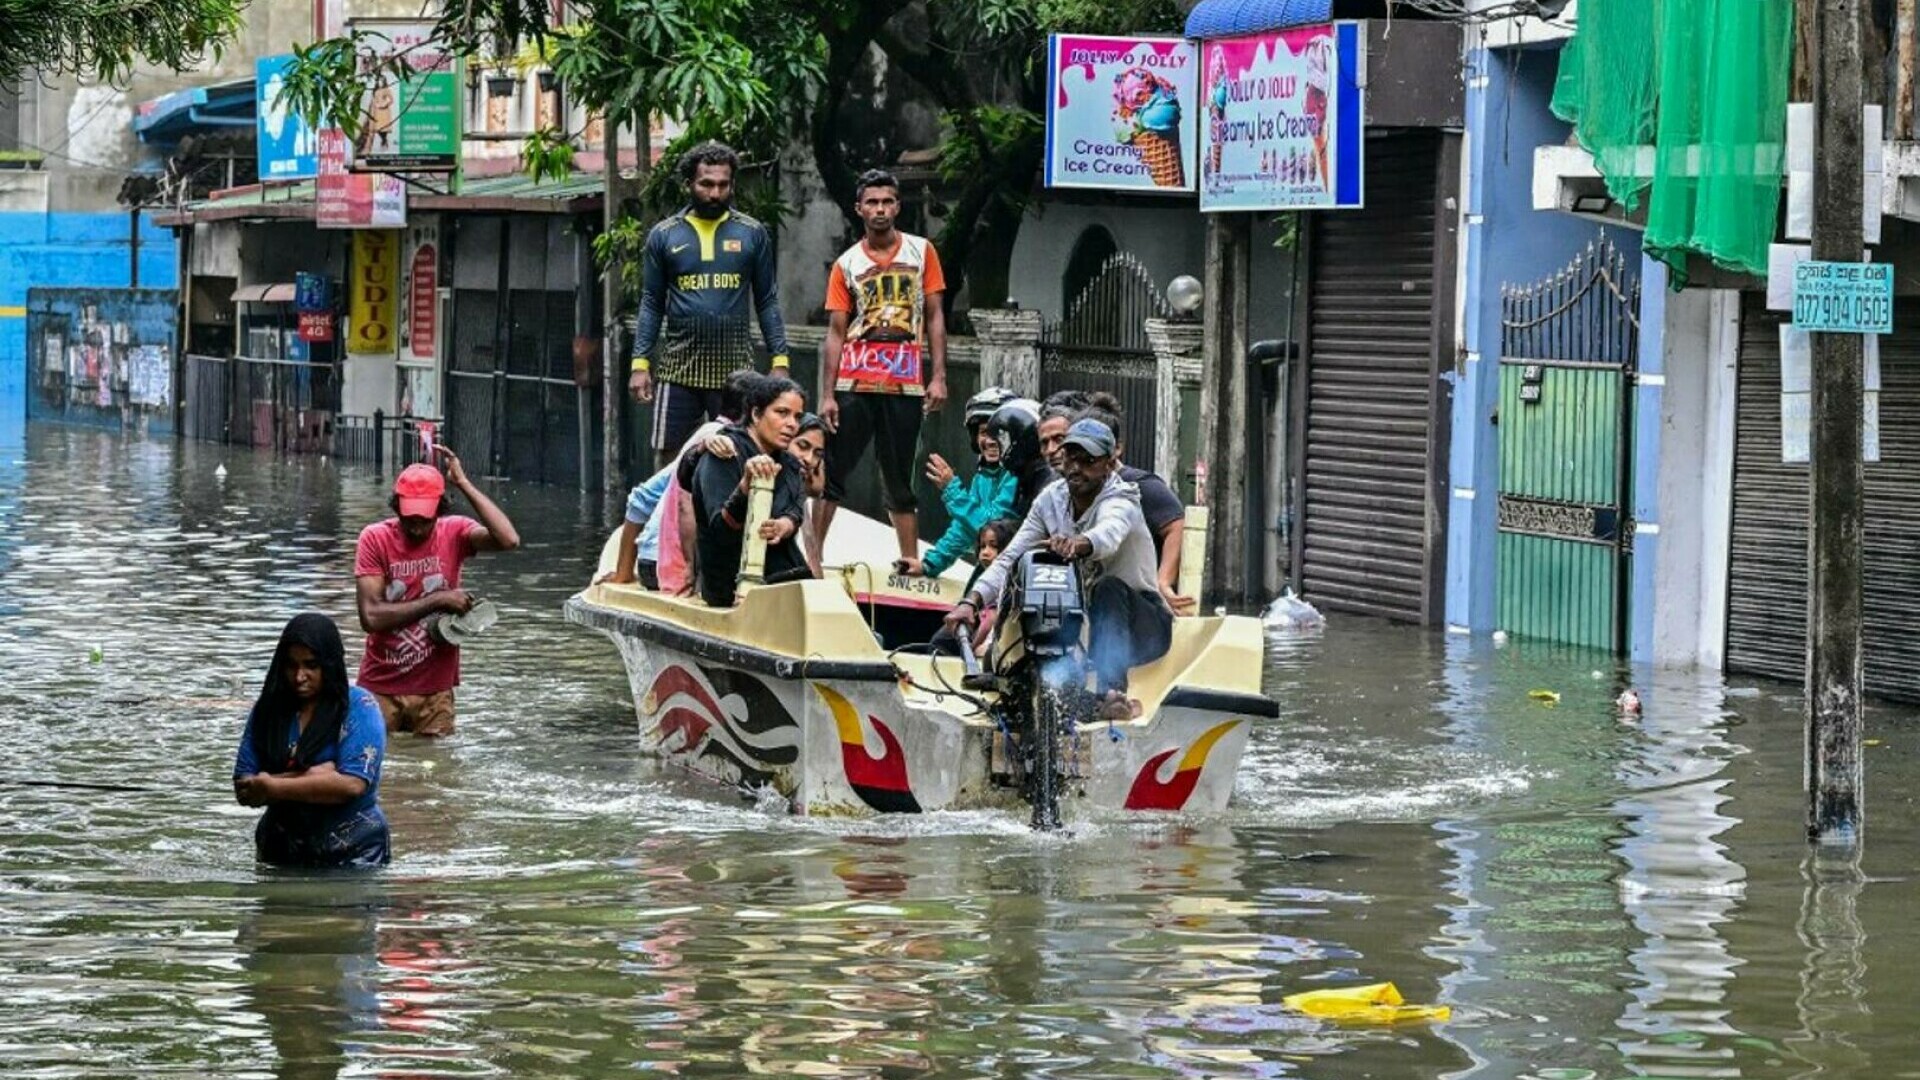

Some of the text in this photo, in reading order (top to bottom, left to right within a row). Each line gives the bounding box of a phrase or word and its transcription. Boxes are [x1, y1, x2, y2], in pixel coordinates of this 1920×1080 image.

[1071, 49, 1186, 68] JOLLY O JOLLY
[1258, 77, 1265, 100] O
[1211, 110, 1319, 147] Creamy Ice Cream
[1074, 140, 1142, 160] Creamy
[1064, 158, 1151, 175] Ice Cream
[359, 228, 388, 341] STUDIO
[678, 273, 741, 290] GREAT BOYS
[1796, 294, 1889, 325] 077 904 0503
[301, 315, 329, 326] airtel
[306, 326, 324, 337] 4G
[1033, 566, 1068, 582] 25
[887, 574, 941, 595] SNL-514
